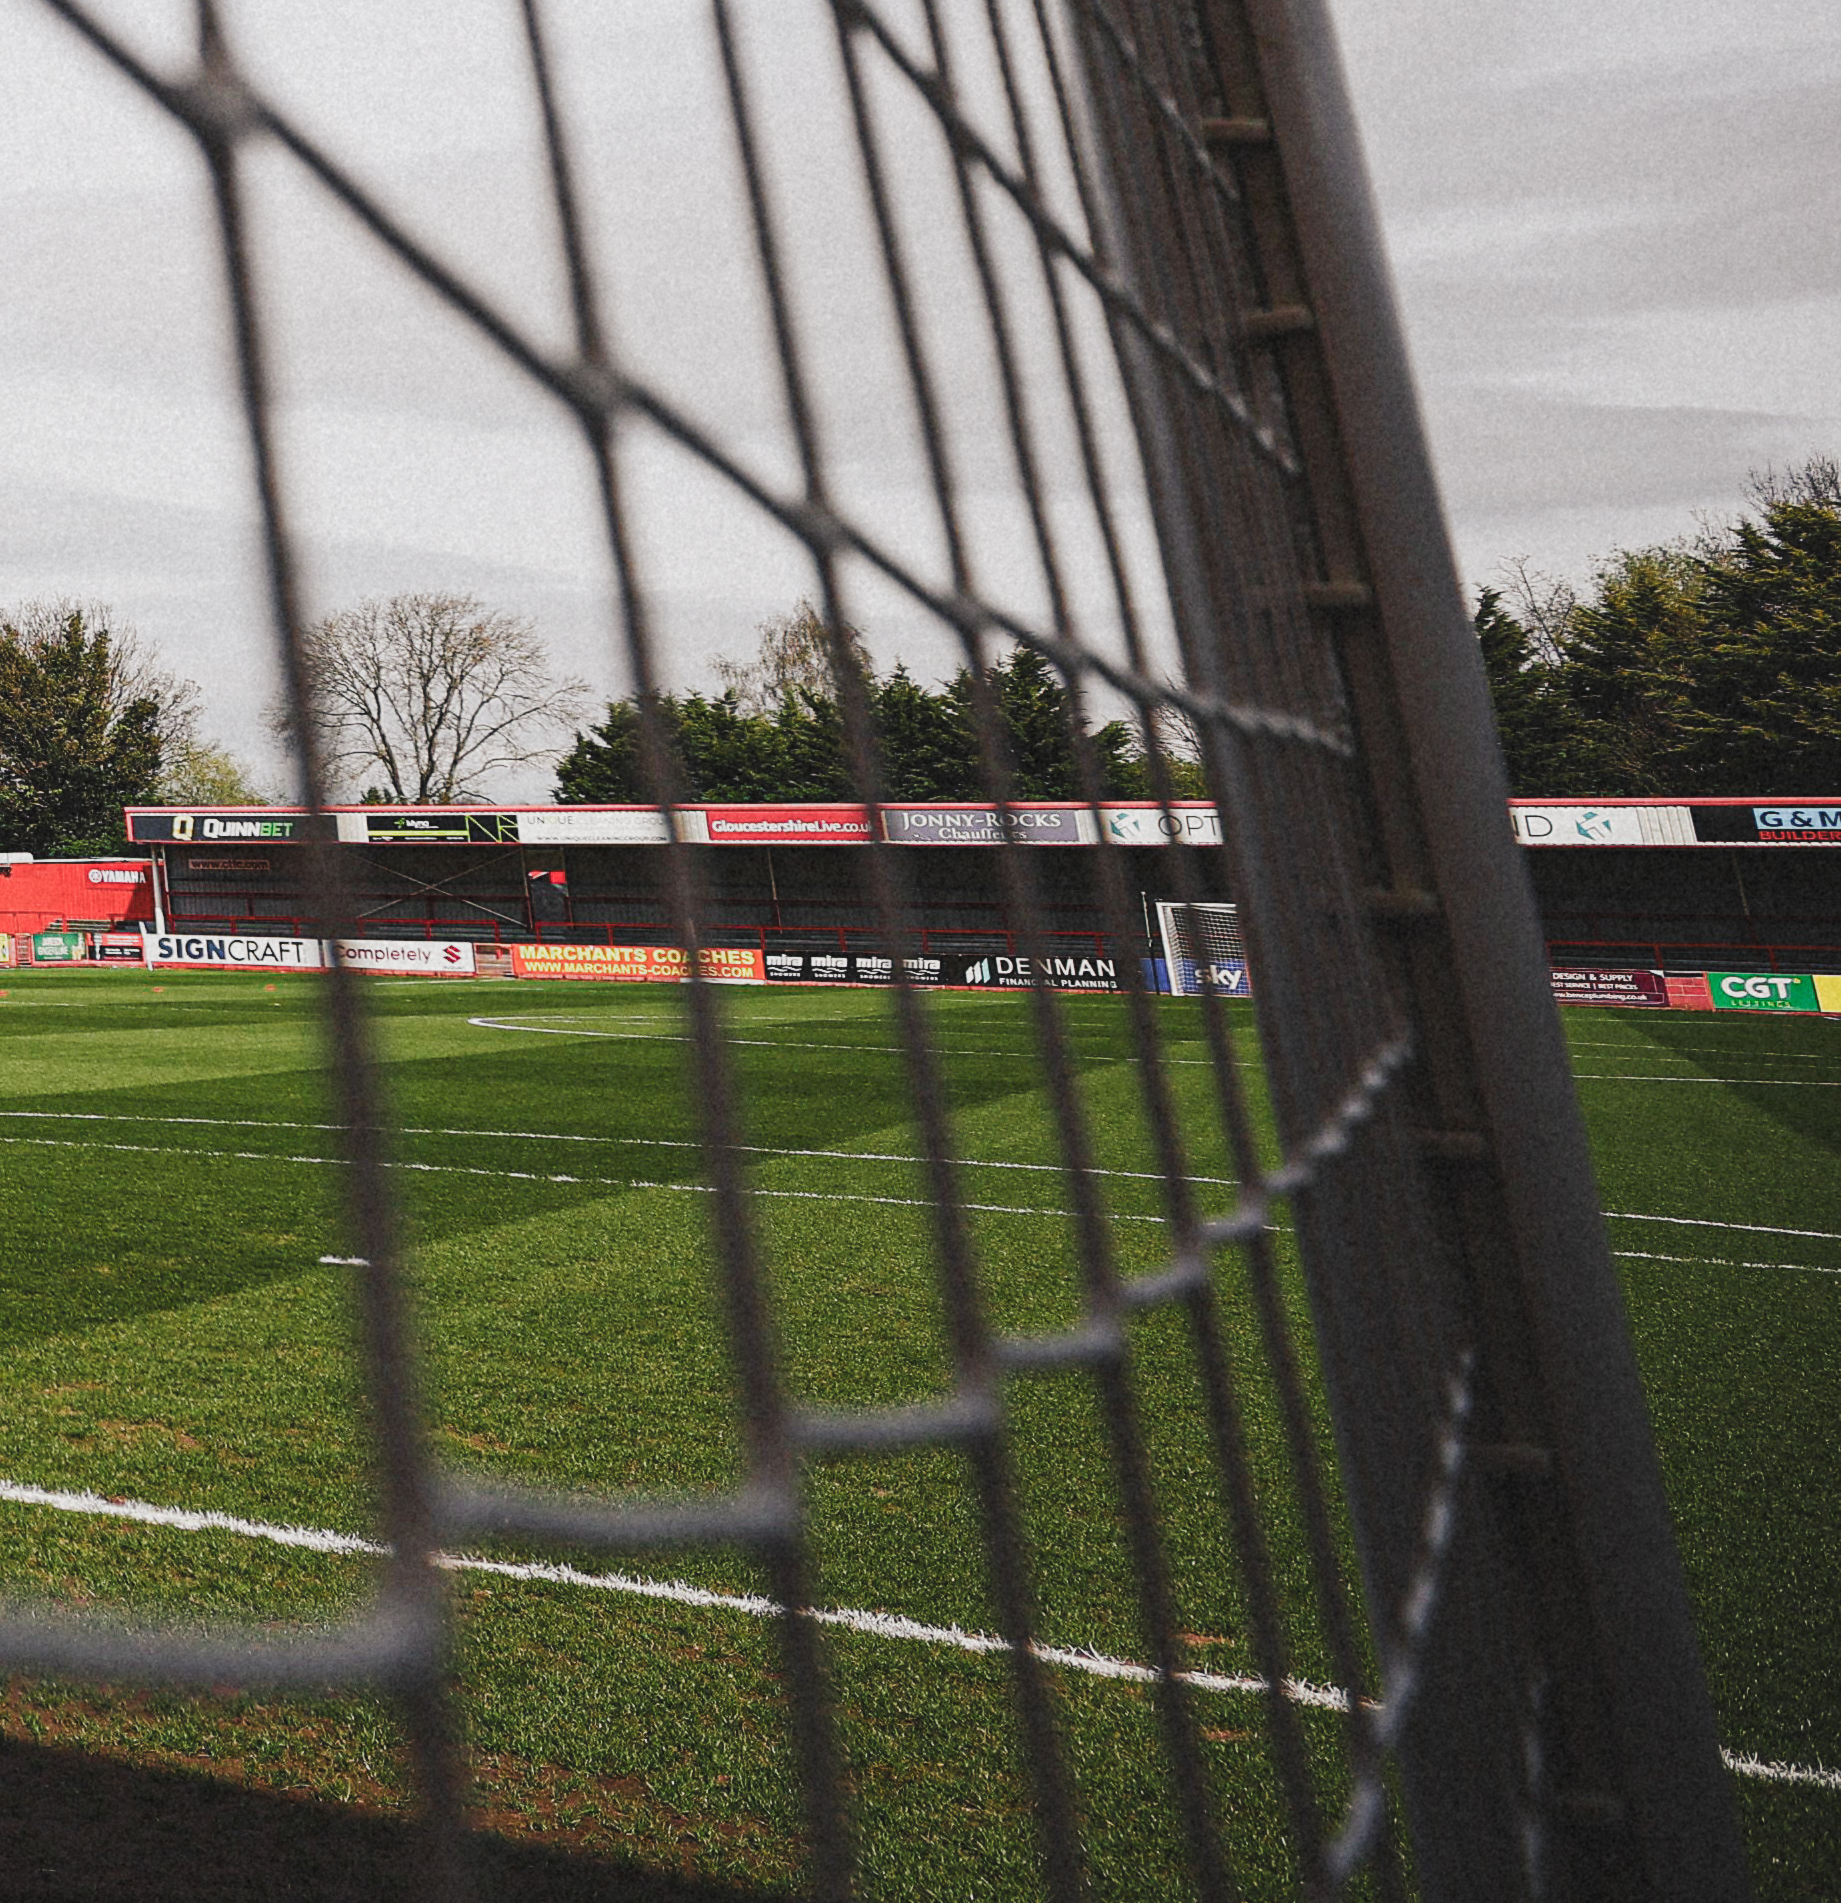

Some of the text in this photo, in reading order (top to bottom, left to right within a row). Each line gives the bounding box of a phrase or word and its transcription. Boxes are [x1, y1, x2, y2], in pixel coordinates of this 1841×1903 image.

[527, 815, 573, 825] UNIQUE
[633, 817, 665, 826] GROU
[1760, 811, 1841, 827] G & M
[712, 819, 870, 835] GloucestershireLive.co.u
[1759, 830, 1841, 841] BUILDER
[102, 870, 146, 883] YAMAHA
[158, 937, 303, 964] SIGNCRAFT
[519, 945, 648, 963] MARCHANTS
[766, 954, 803, 967] mira
[810, 955, 848, 968] mira
[856, 956, 893, 969] mira
[903, 958, 941, 970] mira
[995, 956, 1116, 977] DENMAN
[524, 961, 754, 979] WWW.MARCHANTS-COACES.COM
[999, 977, 1118, 989] FINANCAL PLANNING
[1552, 972, 1586, 981] DESIGN
[1599, 974, 1633, 982] SUPPLY
[1720, 975, 1794, 999] CGT
